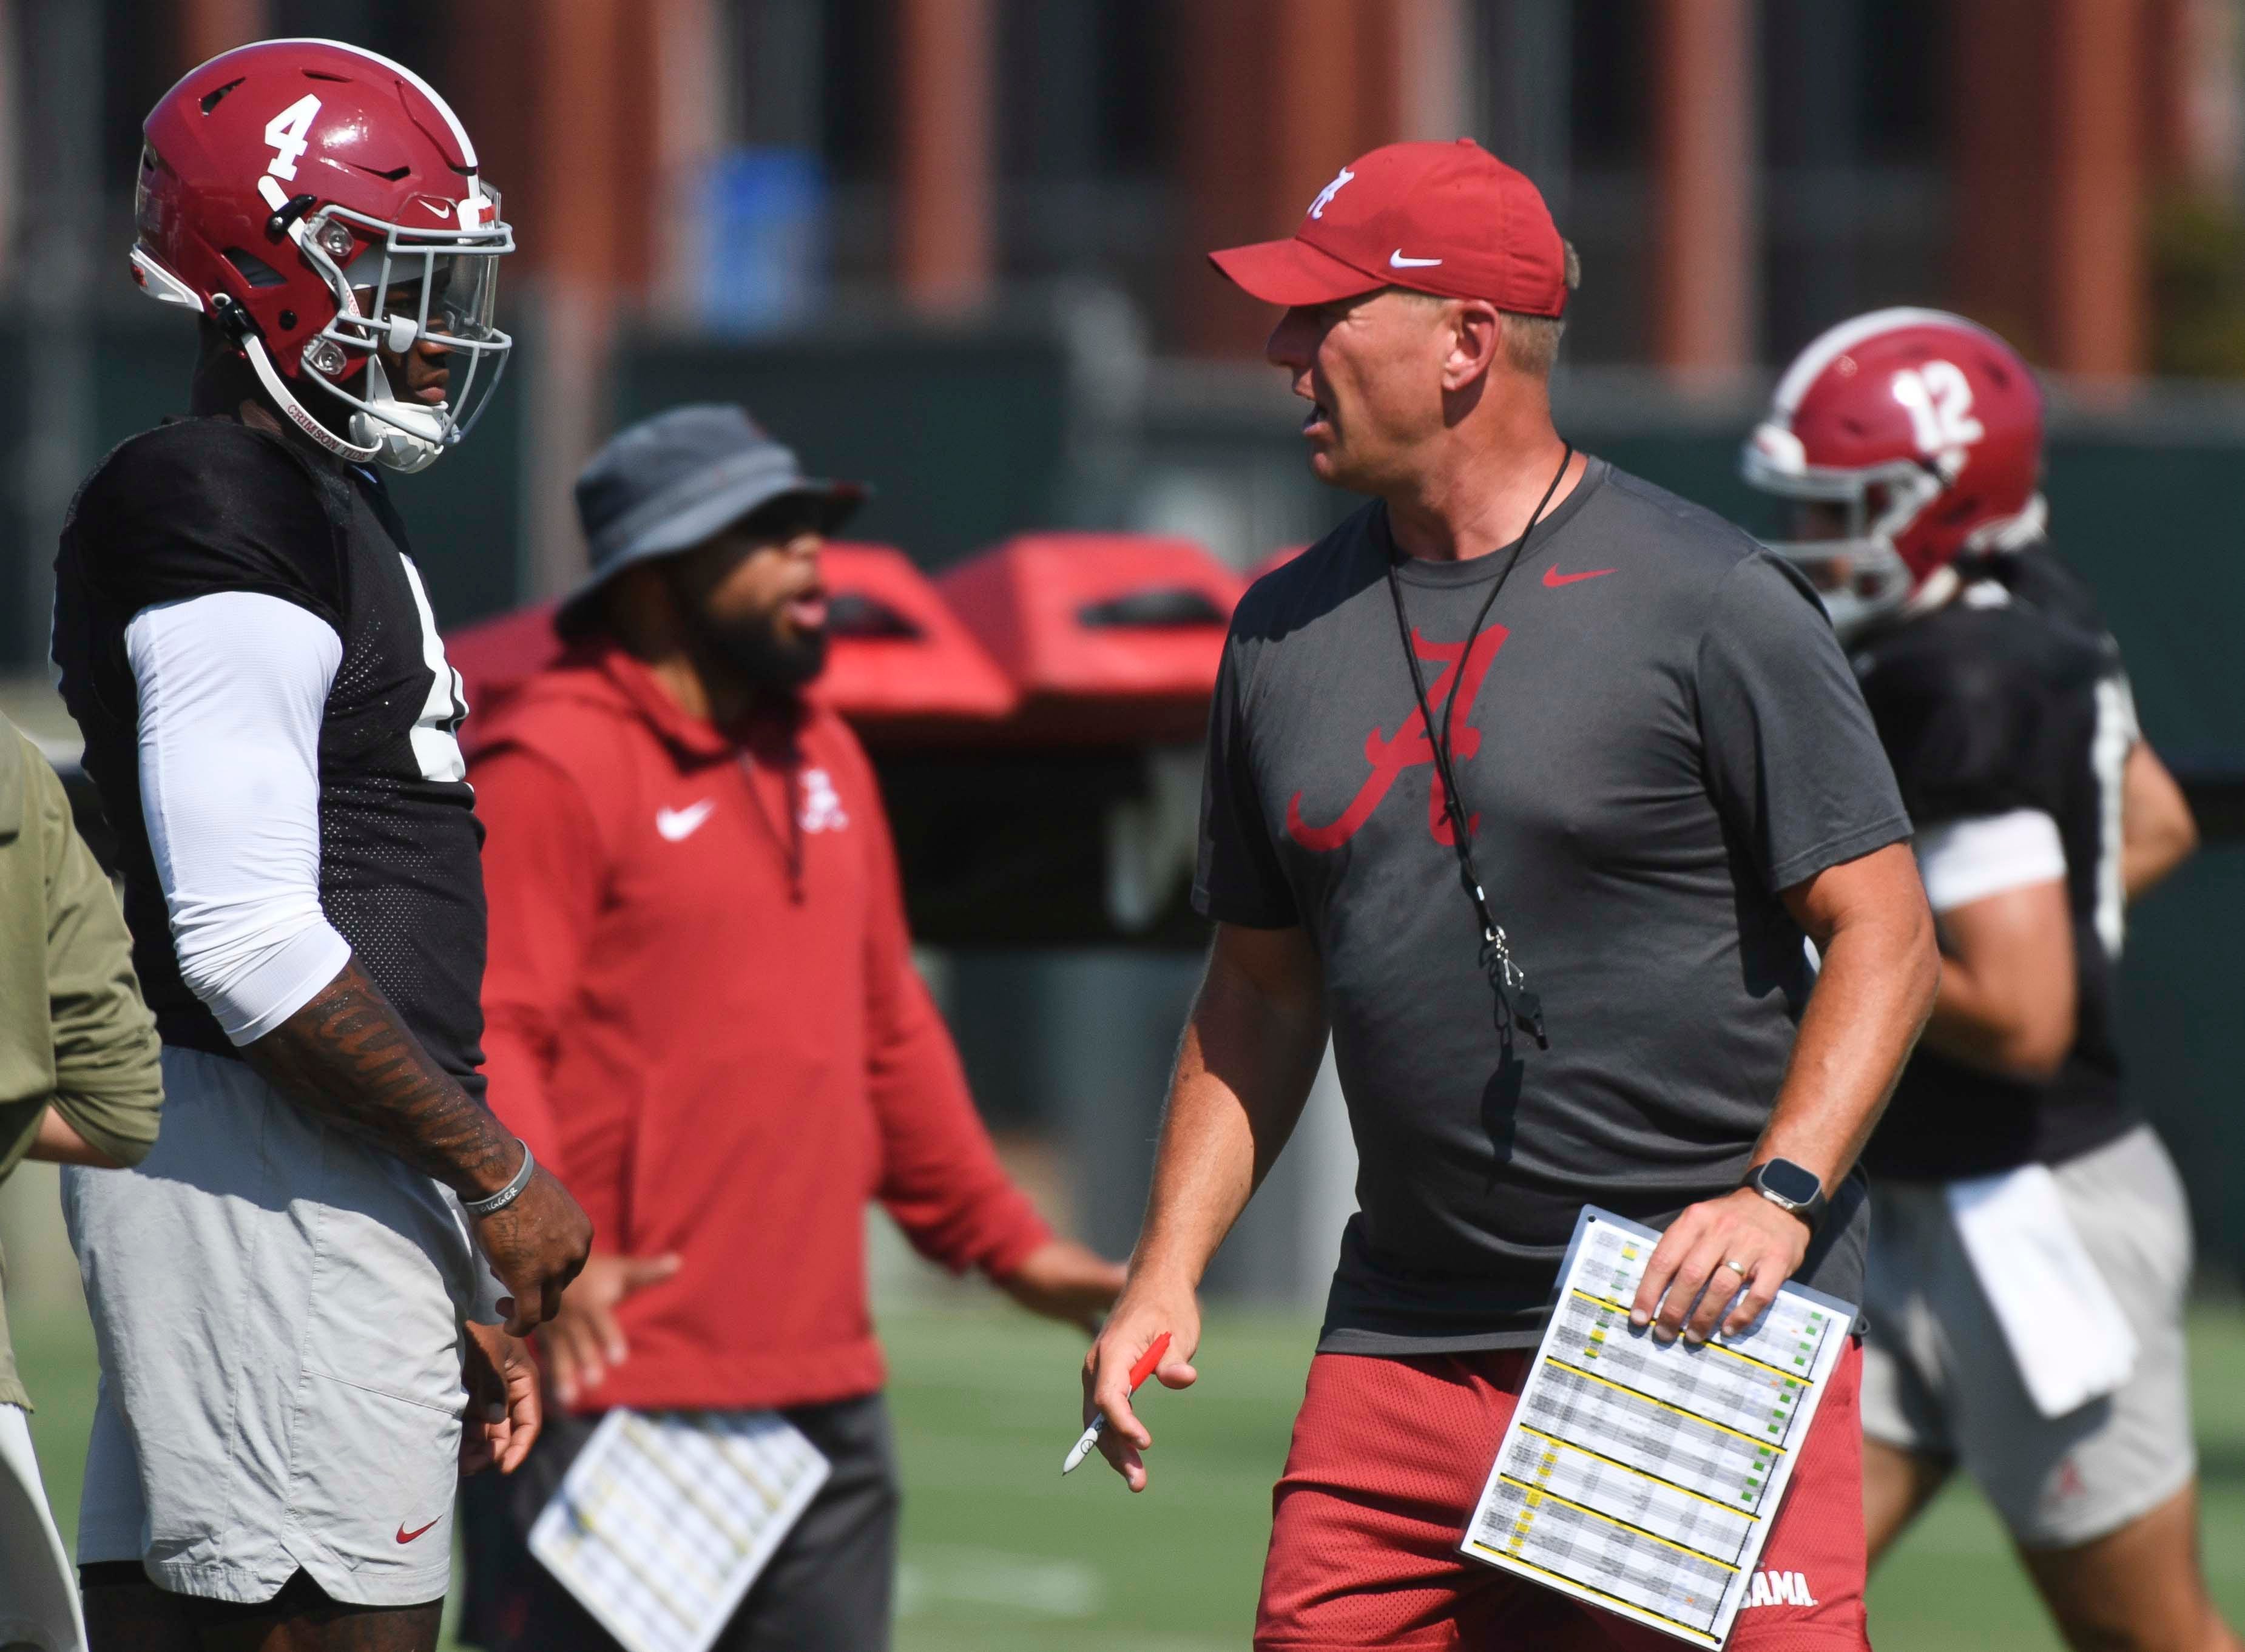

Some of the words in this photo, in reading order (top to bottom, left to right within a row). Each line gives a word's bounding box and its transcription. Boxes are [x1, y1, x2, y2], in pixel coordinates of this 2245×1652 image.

[265, 93, 322, 181] 4
[288, 404, 339, 451] CRIMSON
[343, 447, 369, 461] TIDE
[1891, 359, 1985, 453] 12
[1286, 623, 1510, 851] A
